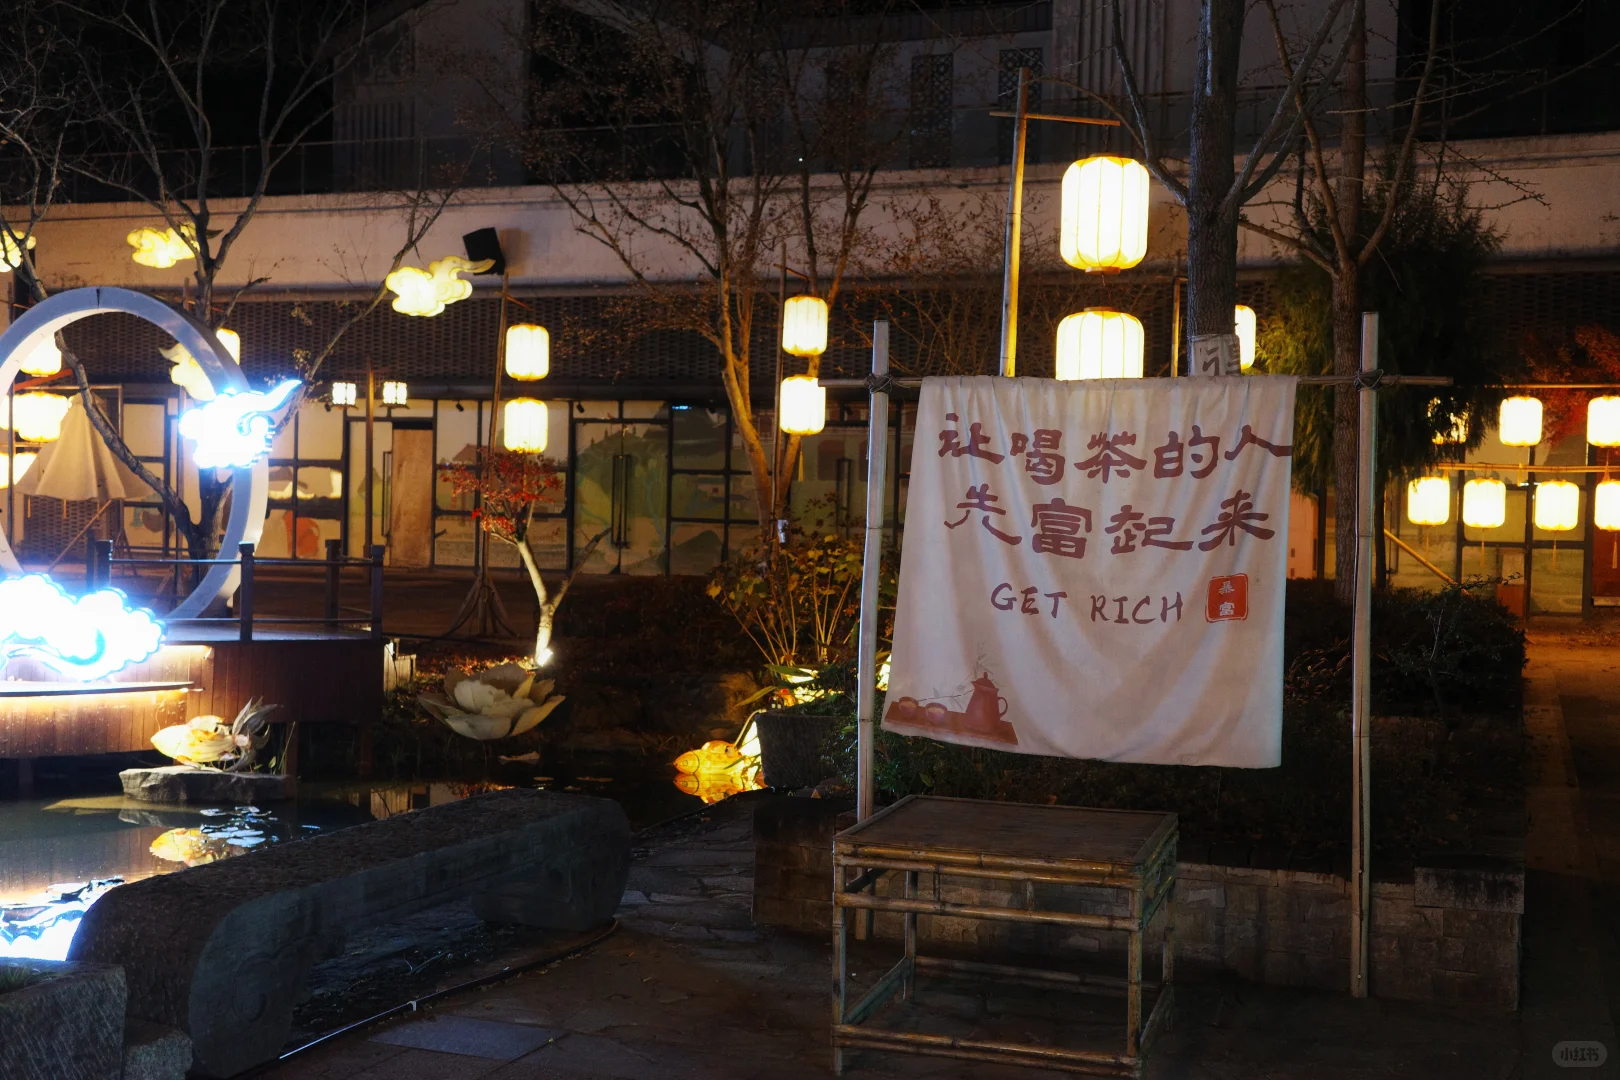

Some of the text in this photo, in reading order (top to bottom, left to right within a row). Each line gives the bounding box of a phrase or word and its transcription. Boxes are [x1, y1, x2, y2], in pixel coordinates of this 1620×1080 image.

[938, 412, 1293, 486] 让喝茶的人
[943, 483, 1275, 560] 先富起来
[990, 582, 1183, 625] GET RICH
